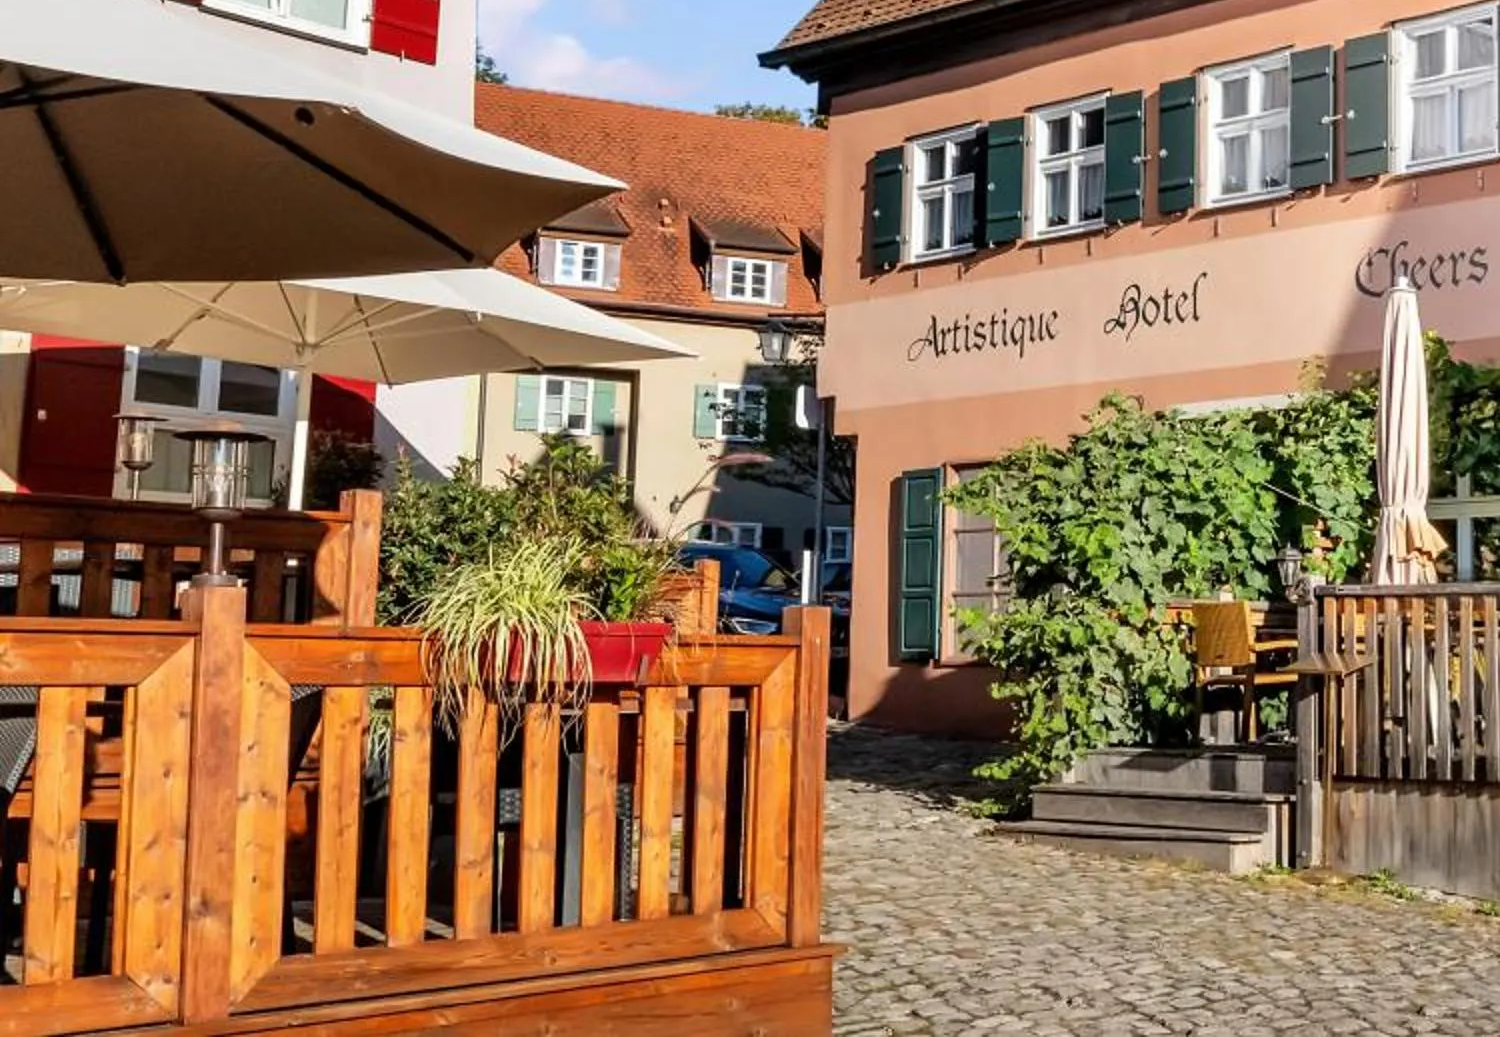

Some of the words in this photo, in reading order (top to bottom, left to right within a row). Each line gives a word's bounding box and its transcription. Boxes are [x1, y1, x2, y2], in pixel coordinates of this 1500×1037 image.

[1355, 240, 1489, 298] Cheers
[907, 307, 1059, 362] Artistique
[1104, 272, 1208, 341] Hotel
